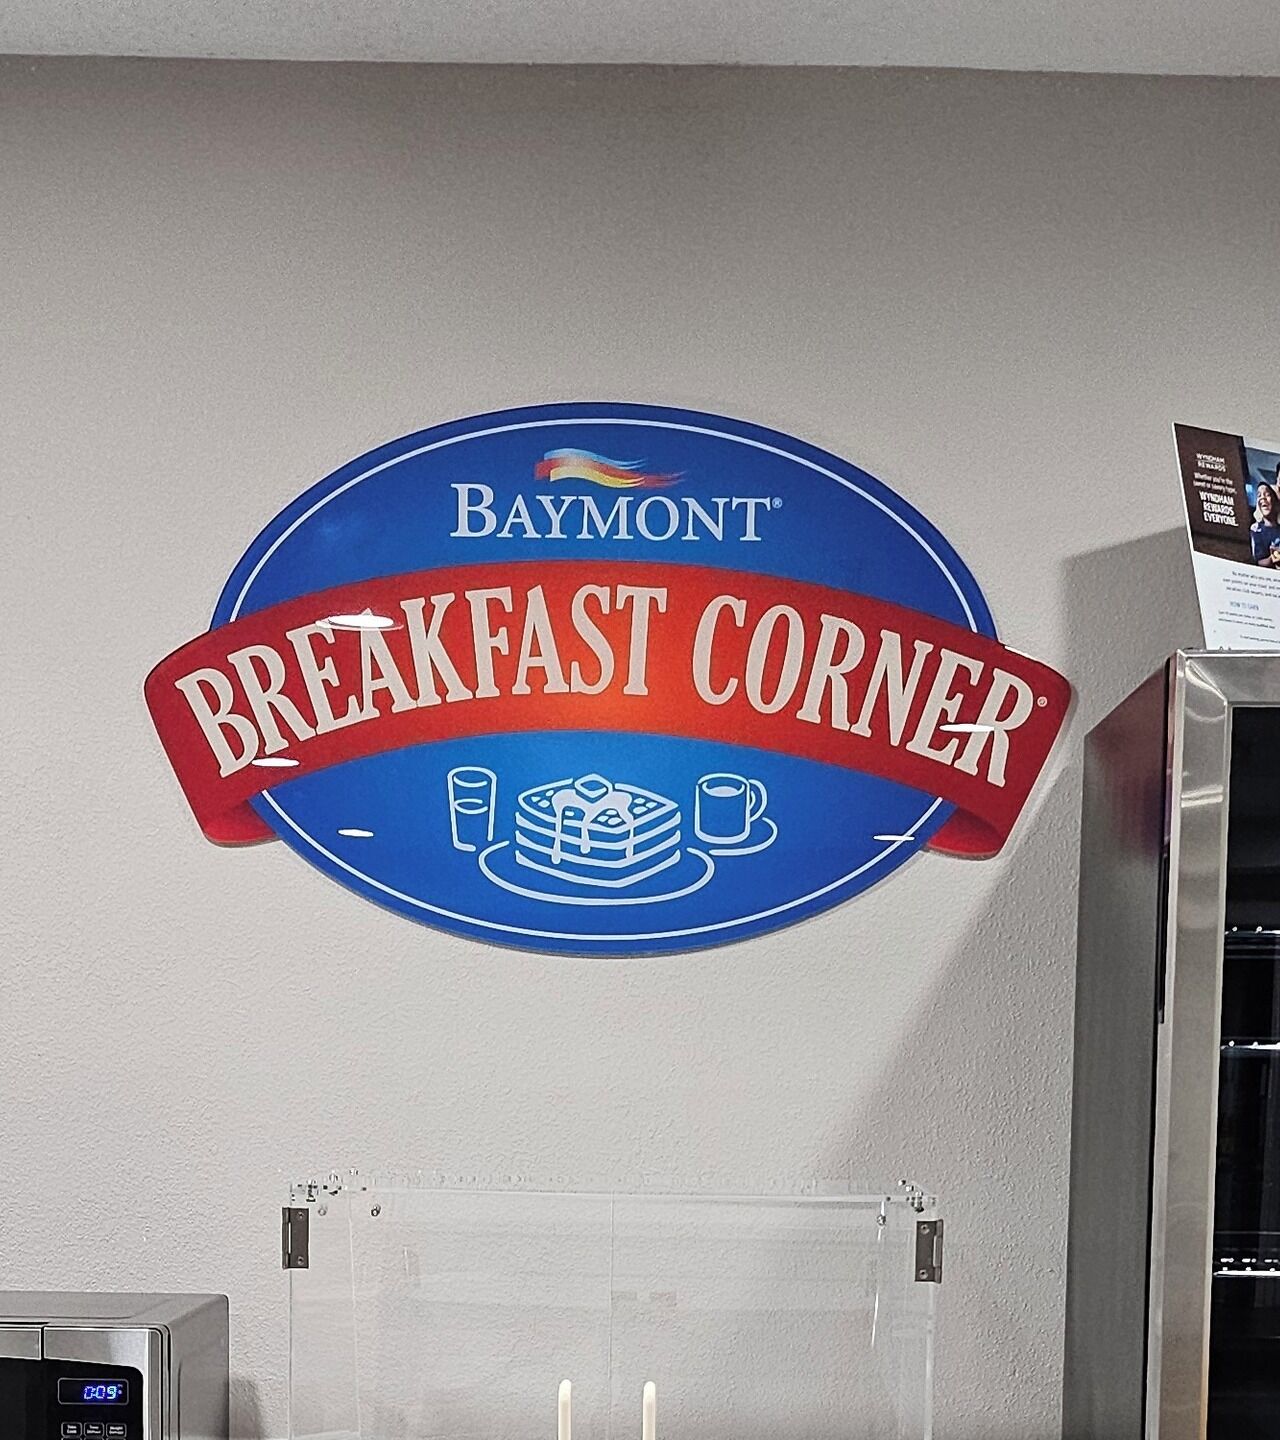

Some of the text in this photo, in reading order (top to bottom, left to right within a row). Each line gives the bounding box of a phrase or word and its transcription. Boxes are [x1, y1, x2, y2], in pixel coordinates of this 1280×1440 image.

[1199, 490, 1234, 505] WYNDHAM
[1203, 501, 1234, 515] REWARDS
[1203, 511, 1239, 526] EVERYONE.
[175, 584, 668, 778] BREAKFAST
